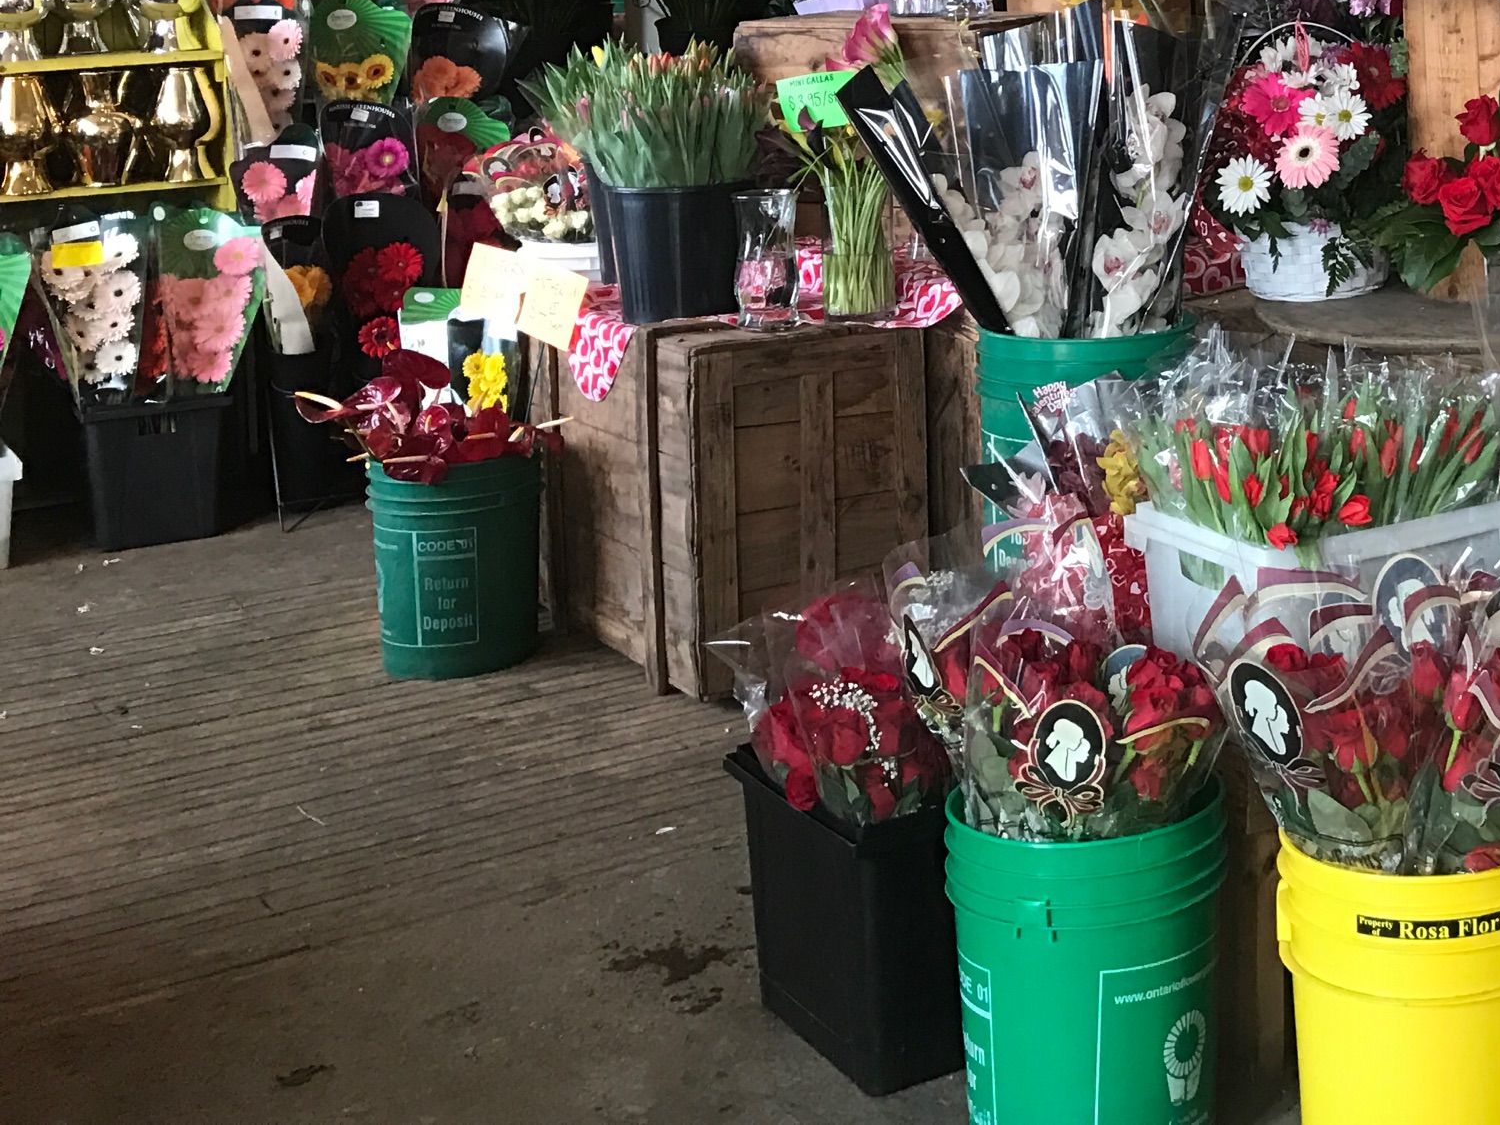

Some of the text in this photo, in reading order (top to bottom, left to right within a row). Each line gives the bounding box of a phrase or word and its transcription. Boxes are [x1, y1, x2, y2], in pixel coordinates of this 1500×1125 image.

[806, 74, 835, 85] CALLAS
[1032, 380, 1067, 399] Happy
[417, 541, 456, 552] CODE
[424, 577, 469, 591] Return
[437, 596, 457, 610] for
[423, 613, 474, 633] Deposit
[1359, 915, 1394, 931] Property
[1371, 928, 1382, 937] of
[1399, 921, 1450, 940] Rosa
